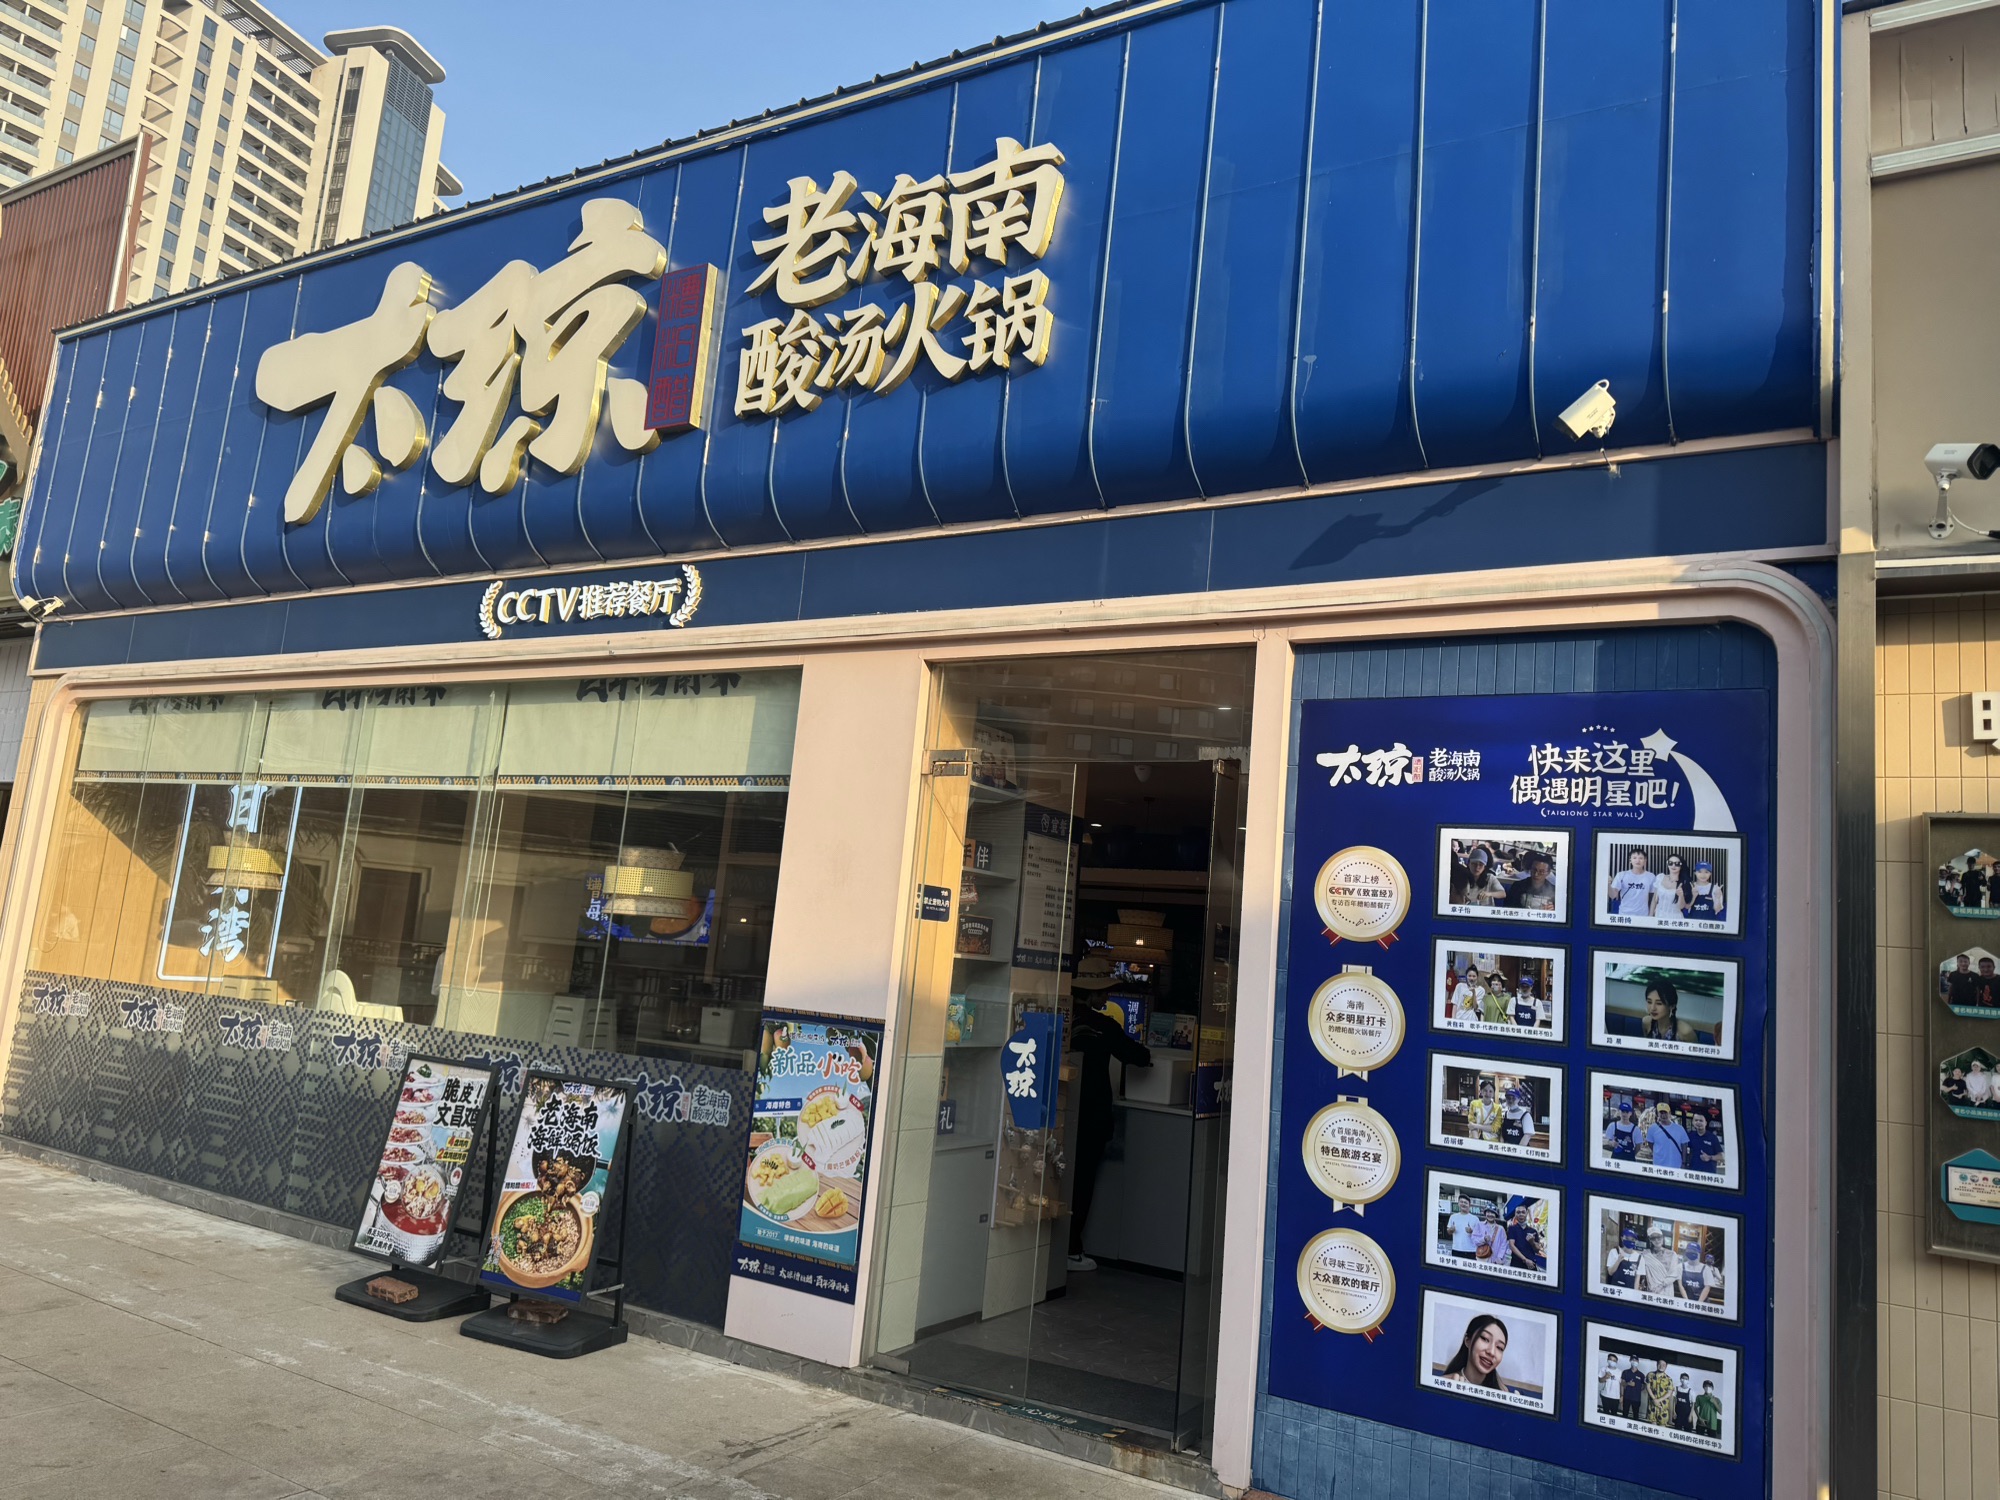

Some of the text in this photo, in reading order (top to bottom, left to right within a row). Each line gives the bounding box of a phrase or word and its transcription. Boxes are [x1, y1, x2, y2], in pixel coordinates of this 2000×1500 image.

[744, 136, 1065, 309] 老海南
[651, 272, 703, 422] 糟粕醋
[733, 268, 1055, 418] 酸汤火锅
[256, 198, 666, 524] 太琼
[497, 578, 683, 625] CCTV推荐餐厅
[1316, 743, 1415, 788] 太琼
[1428, 747, 1481, 768] 老海南
[1528, 742, 1656, 777] 快来这里
[1428, 767, 1481, 783] 酸汤火锅
[1592, 810, 1613, 818] STAR
[976, 846, 989, 868] 伴
[199, 784, 267, 963] 日湾
[1343, 873, 1380, 884] 首家上榜
[1328, 886, 1394, 899] CCTV《致富经》
[1331, 898, 1390, 910] 专访百年糟粕醋餐厅
[1450, 906, 1471, 914] 章子怡
[1609, 916, 1632, 925] 张雨绮
[33, 984, 67, 1015] 太琼
[1346, 1000, 1365, 1011] 海南
[121, 997, 158, 1031] 太琼
[1127, 1000, 1140, 1035] 调料台
[1325, 1011, 1387, 1027] 众多明星打卡
[219, 1012, 262, 1048] 太琼
[1328, 1025, 1382, 1038] 的糟粕醋火锅餐厅
[333, 1031, 382, 1068] 太琼
[772, 1047, 861, 1083] 新品小吃
[1005, 1038, 1037, 1098] 太琼
[694, 1087, 730, 1109] 老海南
[765, 1101, 791, 1109] 海南特色
[433, 1102, 480, 1131] 文昌鸡
[538, 1094, 599, 1130] 老海南
[692, 1106, 729, 1124] 酸汤火锅
[939, 1106, 953, 1130] 礼
[1320, 1145, 1382, 1164] 特色旅游名宴
[737, 1257, 760, 1274] 太琼
[1322, 1257, 1371, 1274] 《寻味三亚》
[1312, 1271, 1380, 1293] 大众喜欢的餐厅
